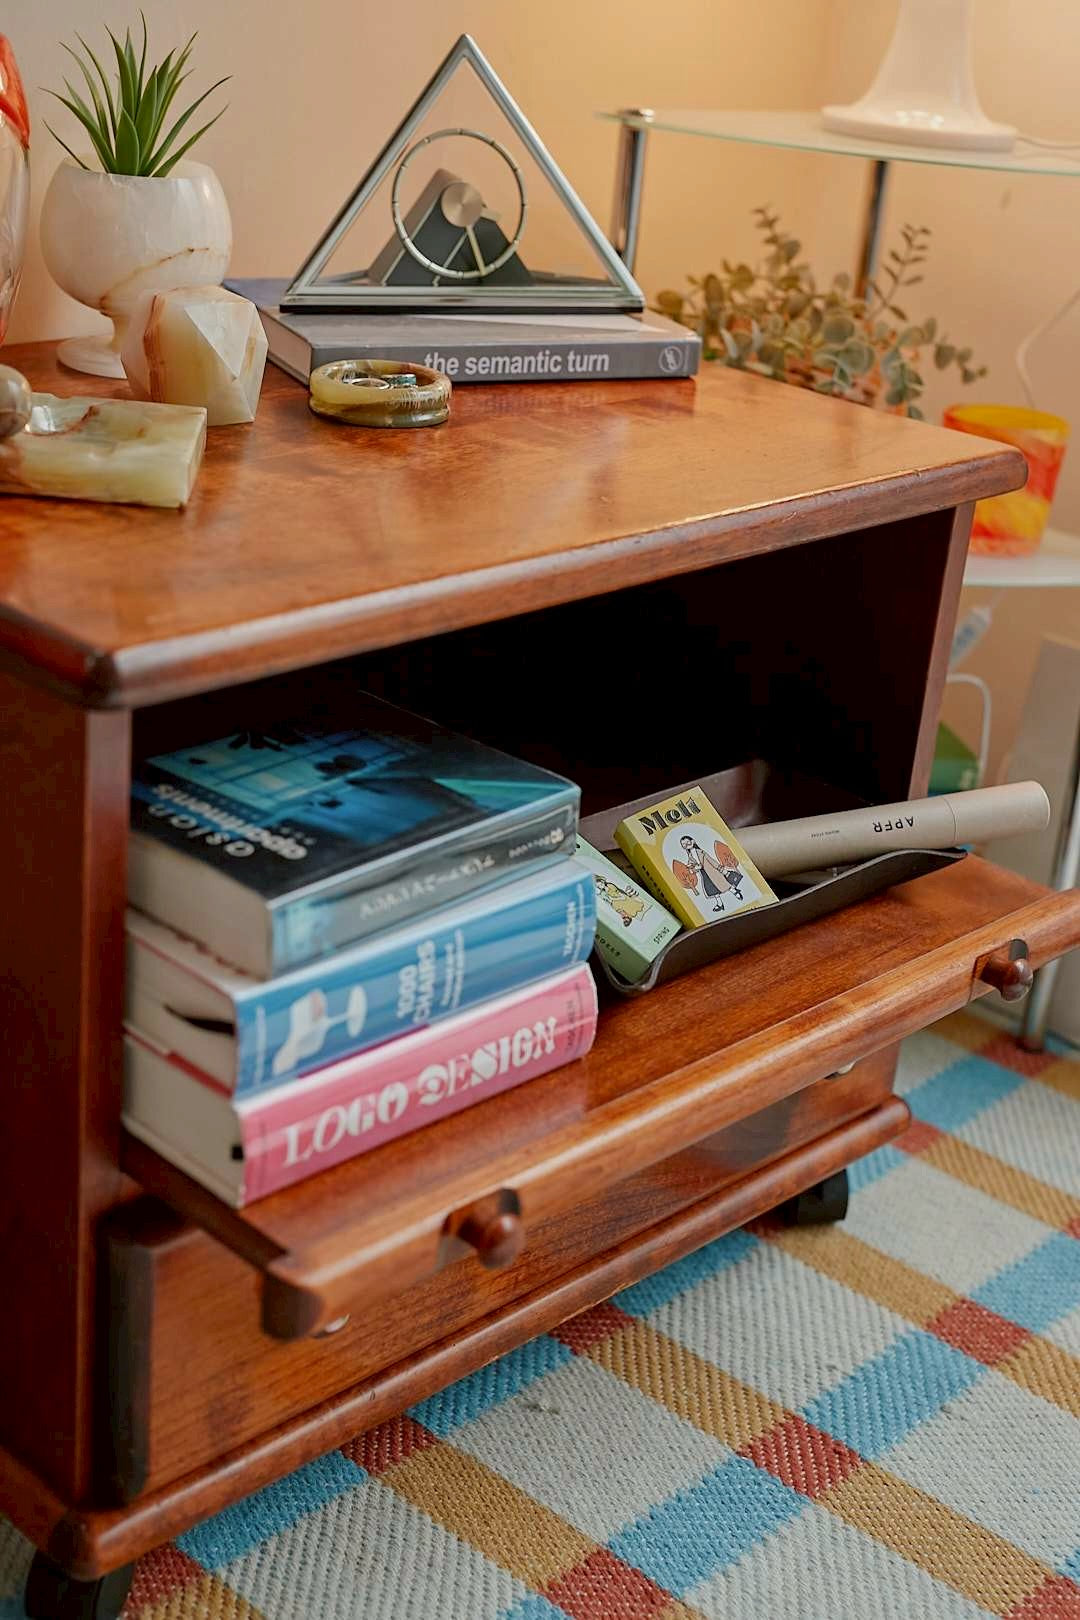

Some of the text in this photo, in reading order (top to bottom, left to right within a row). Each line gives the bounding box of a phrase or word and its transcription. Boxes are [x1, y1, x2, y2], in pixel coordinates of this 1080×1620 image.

[424, 350, 610, 376] the semantic turn
[872, 816, 914, 833] APFR
[282, 1081, 409, 1168] LOGO
[415, 1015, 558, 1106] DESIGN
